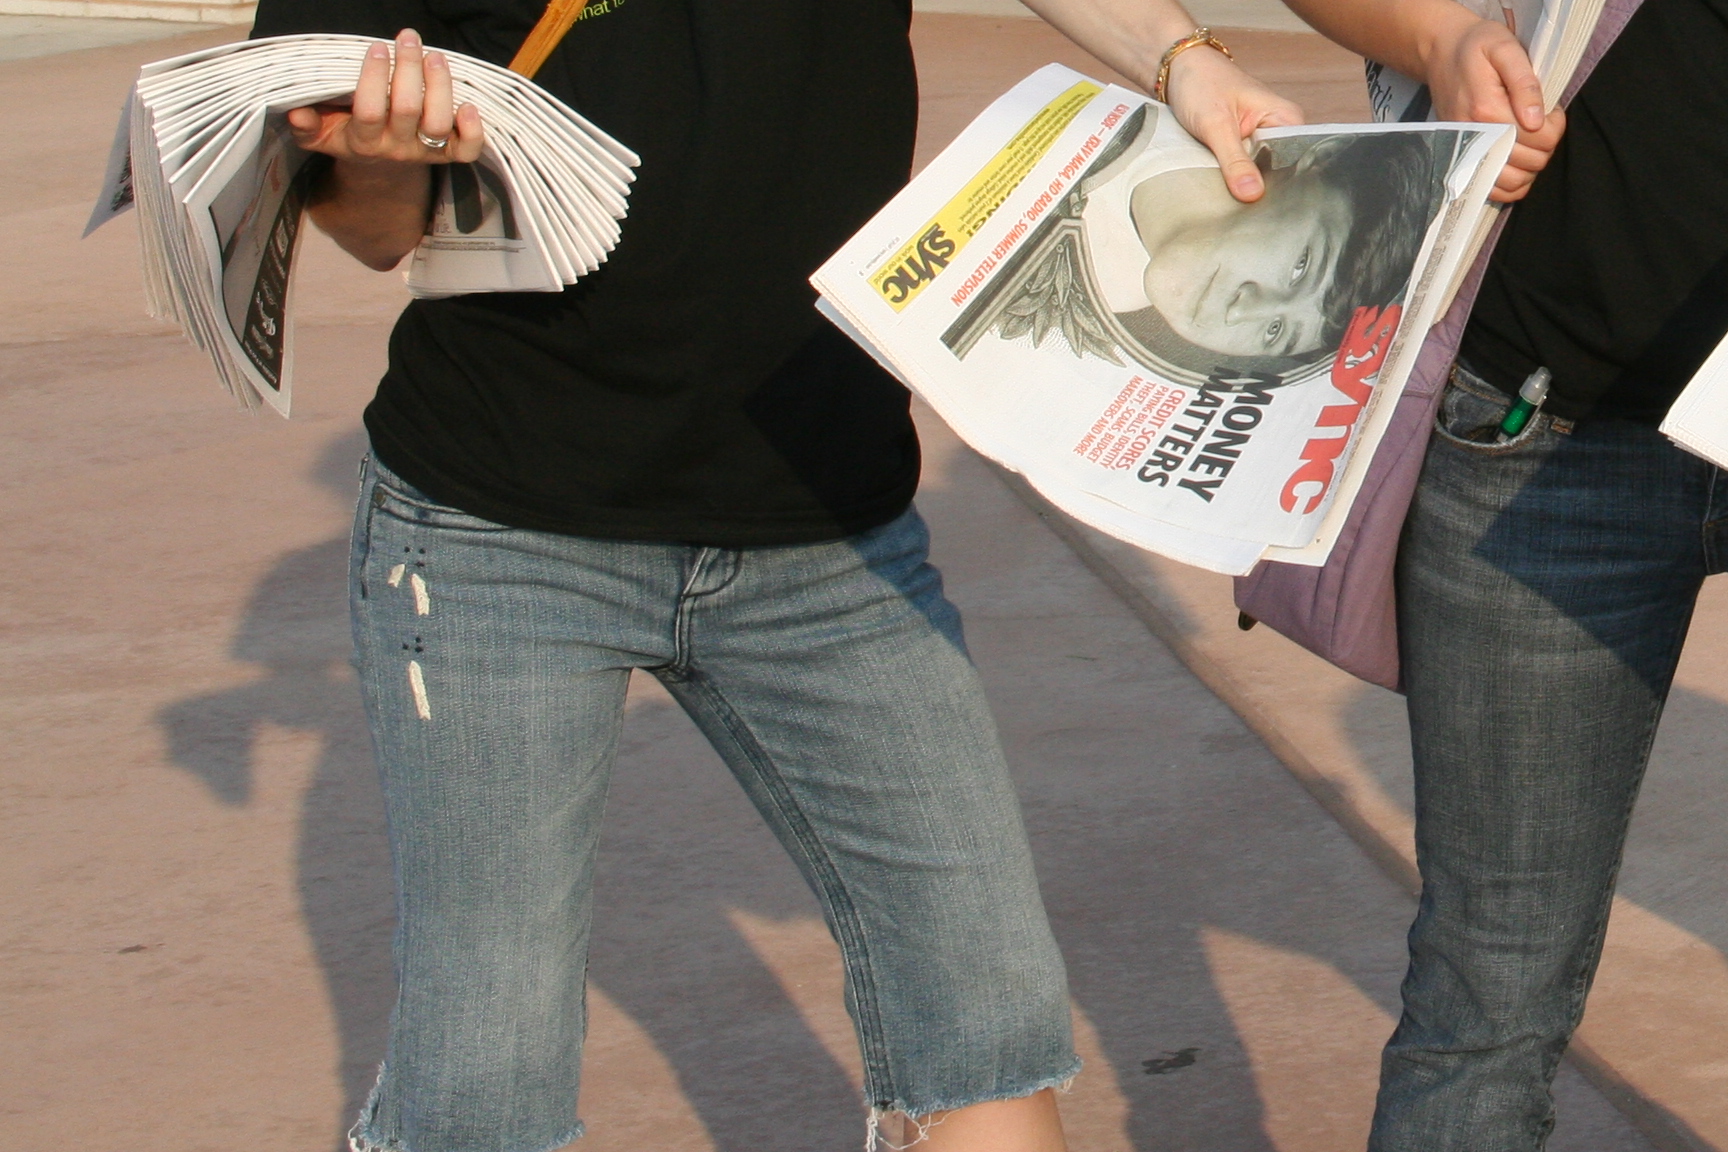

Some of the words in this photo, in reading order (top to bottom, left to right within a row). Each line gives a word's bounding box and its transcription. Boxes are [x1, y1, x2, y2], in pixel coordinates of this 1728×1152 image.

[1078, 134, 1101, 158] KRAV
[1057, 152, 1086, 180] MAGA,
[1047, 178, 1064, 194] HD
[1021, 190, 1053, 220] RADIO,
[991, 218, 1029, 259] SUMMER
[884, 222, 952, 300] sync
[950, 255, 997, 306] TELEVISION
[1103, 374, 1143, 420] MAKEOVERS
[1129, 380, 1156, 404] THEFT,
[1142, 384, 1169, 414] PAYING
[1107, 405, 1135, 432] SCAMS,
[1122, 411, 1147, 434] BILLS,
[1147, 387, 1185, 429] CREDIT
[1280, 305, 1400, 514] sync
[1089, 416, 1110, 435] AND
[1135, 365, 1240, 488] MATTERS
[1176, 376, 1282, 503] MONEY
[1072, 432, 1097, 456] MORE
[1085, 432, 1114, 463] BUDGET
[1099, 433, 1130, 469] IDENTITY
[1109, 427, 1155, 471] SCORES,
